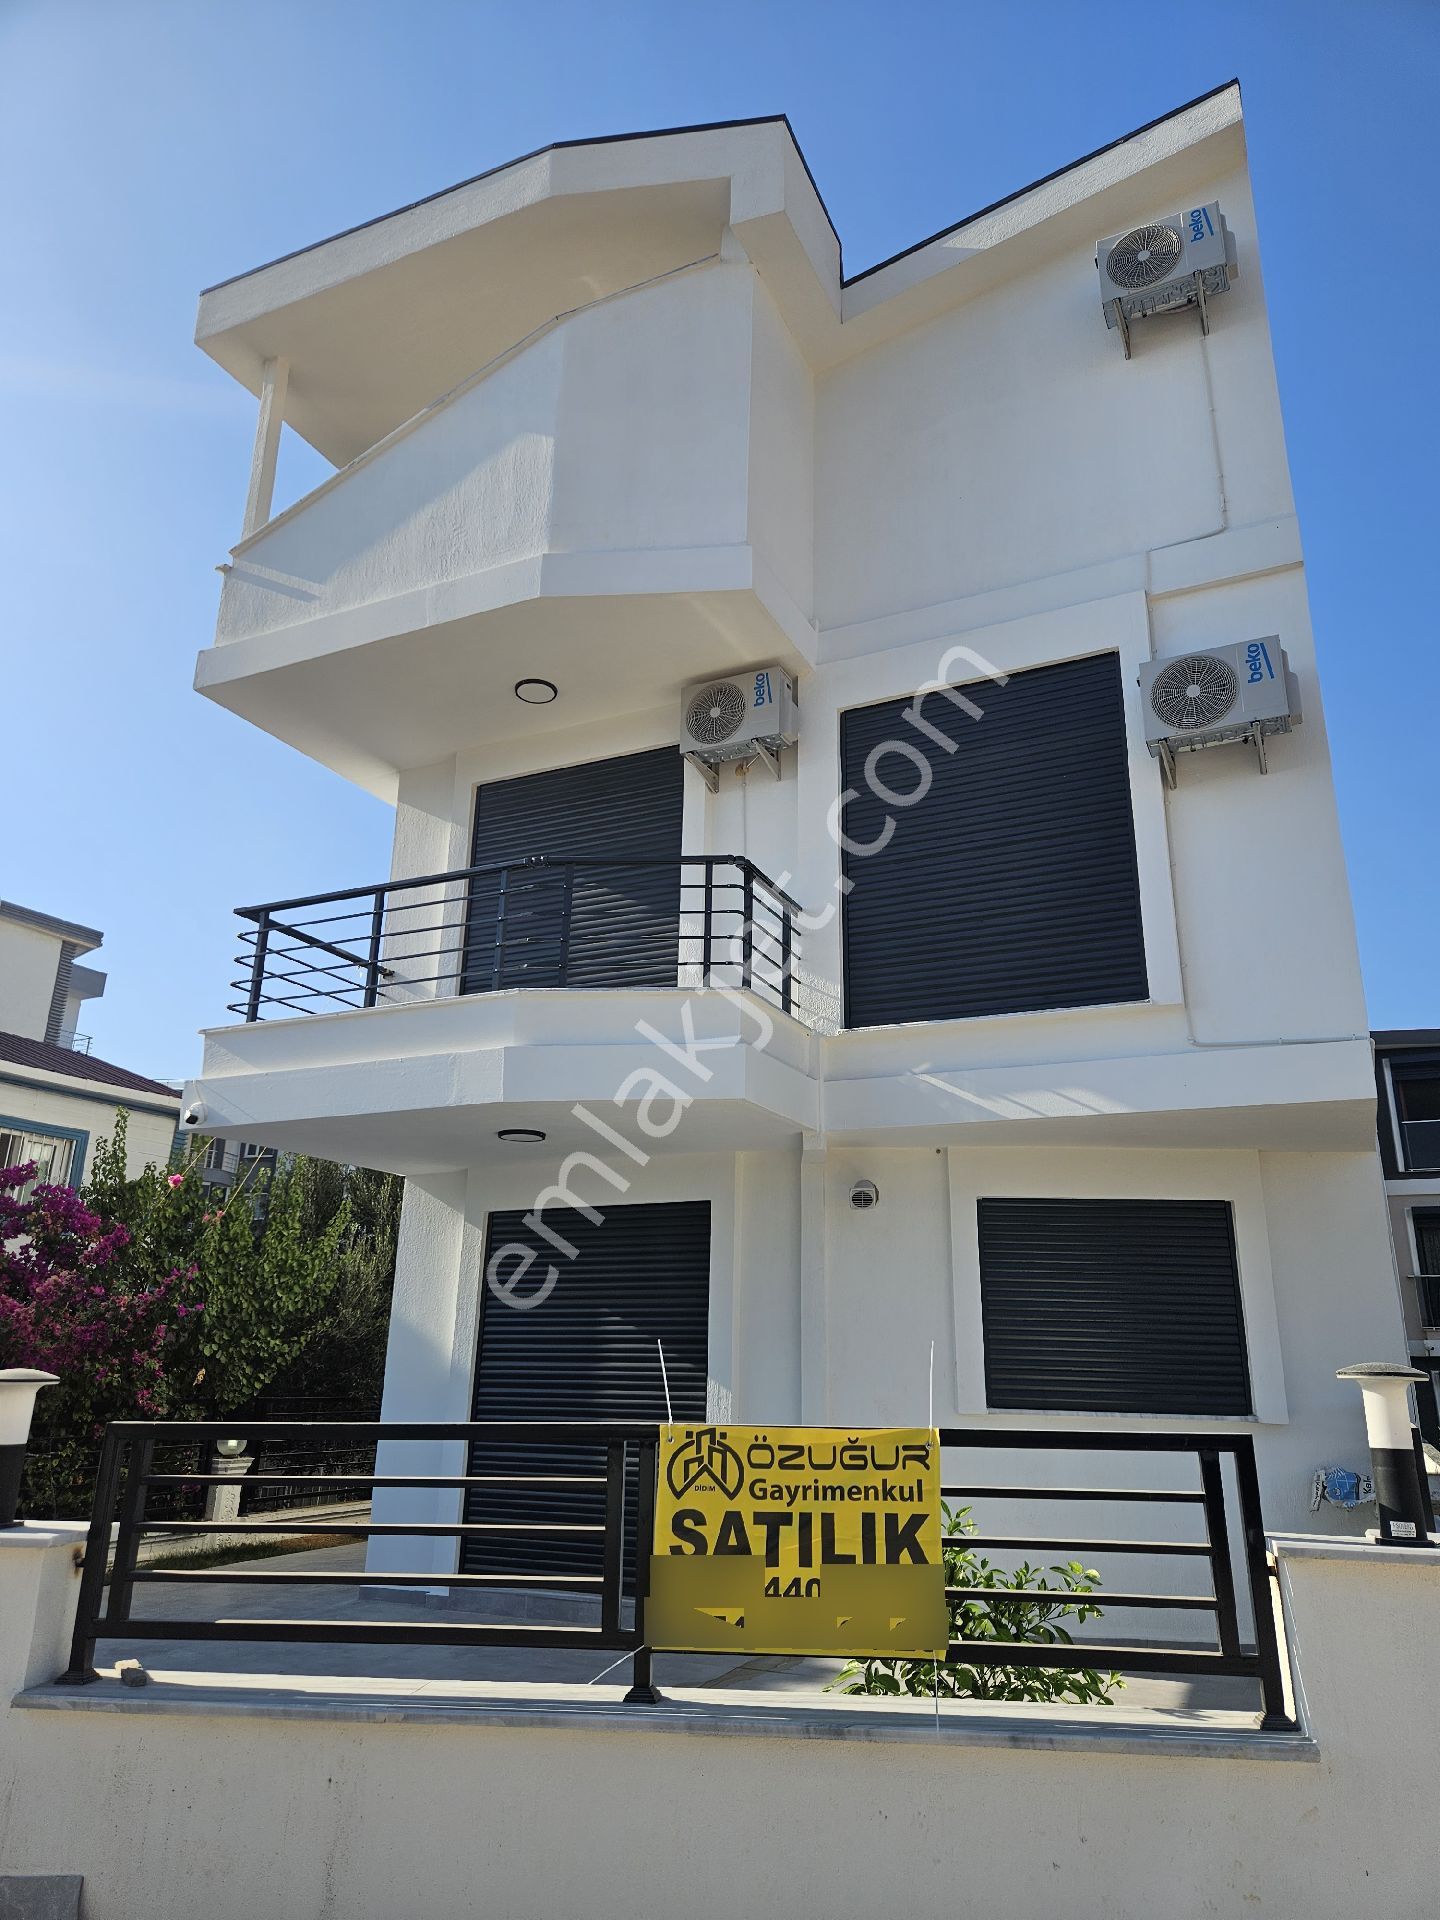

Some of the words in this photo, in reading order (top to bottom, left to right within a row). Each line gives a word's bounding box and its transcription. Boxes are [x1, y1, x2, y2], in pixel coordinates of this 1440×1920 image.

[1189, 209, 1204, 243] beko
[1245, 643, 1263, 684] beko
[753, 673, 765, 707] beko
[747, 1434, 931, 1471] ÖZUĞUR
[748, 1478, 923, 1507] Gayrimenkul
[669, 1508, 931, 1569] SATILIK
